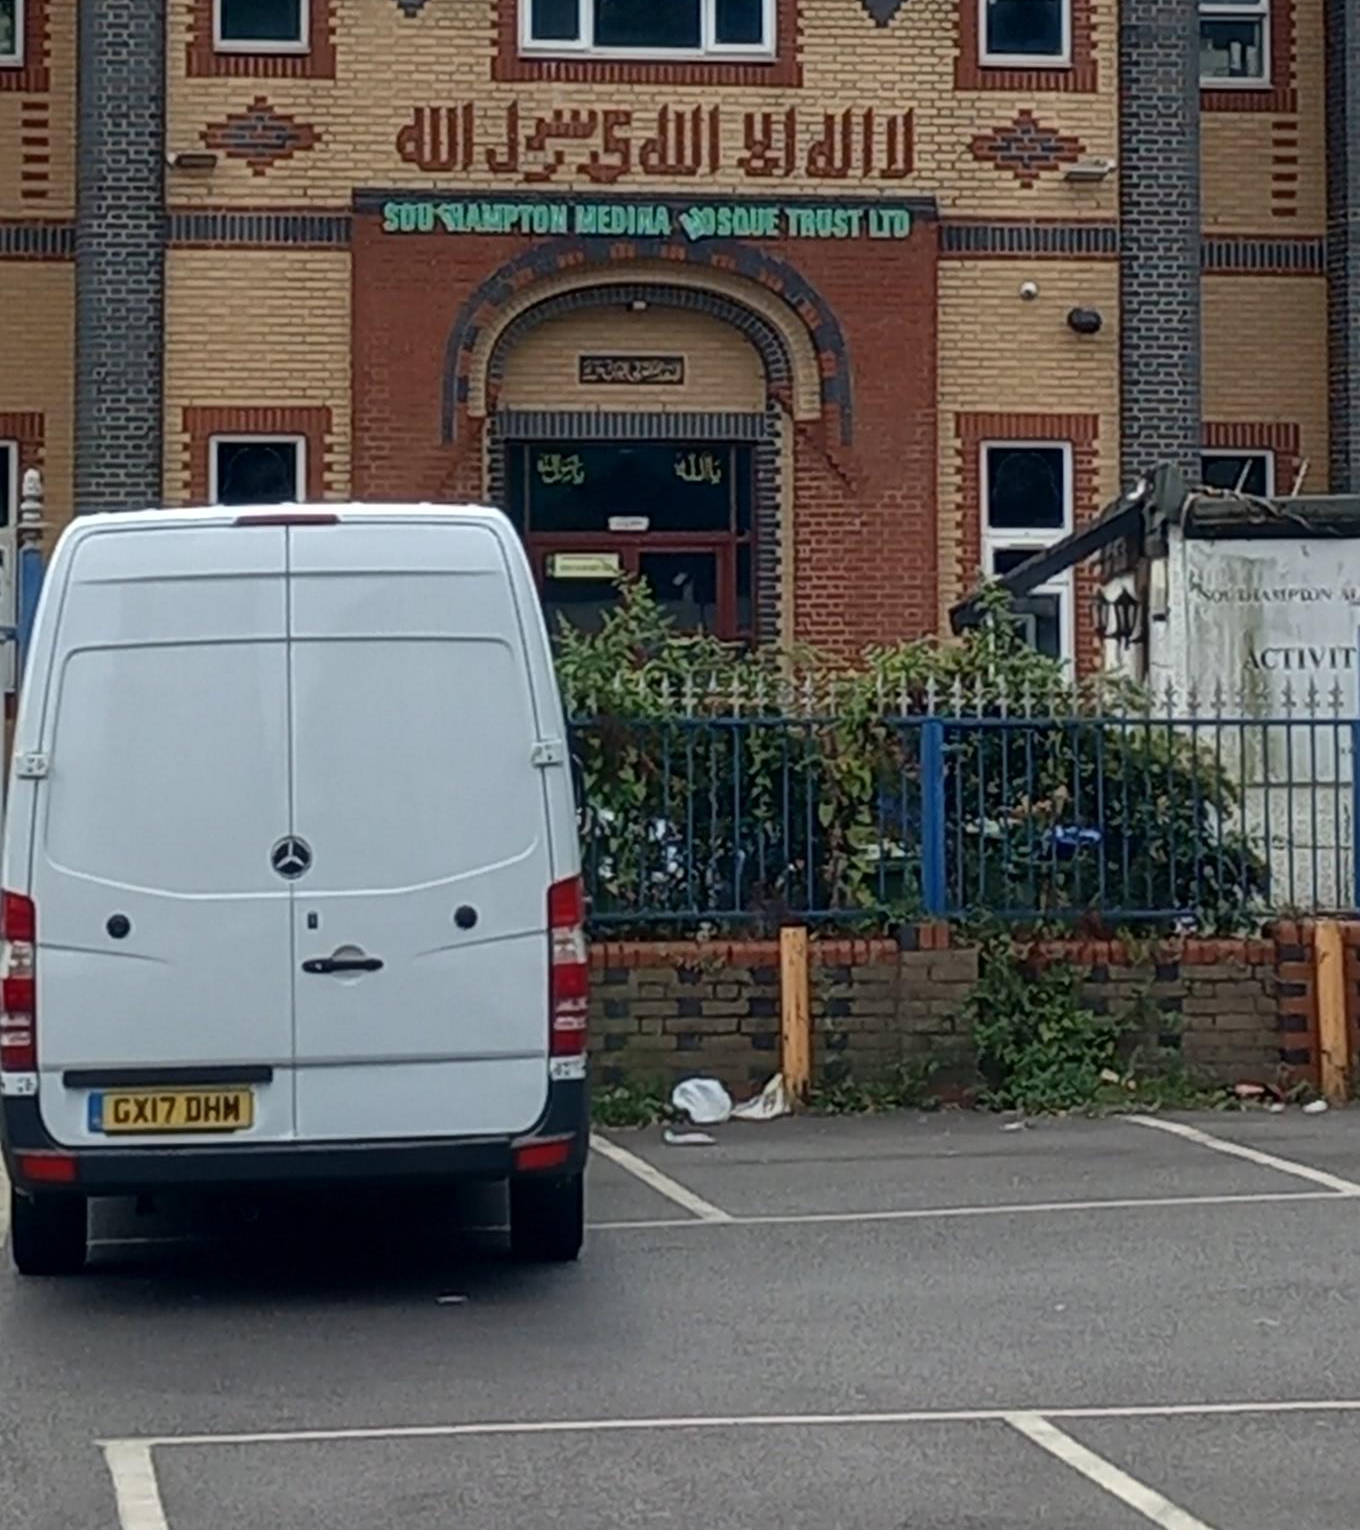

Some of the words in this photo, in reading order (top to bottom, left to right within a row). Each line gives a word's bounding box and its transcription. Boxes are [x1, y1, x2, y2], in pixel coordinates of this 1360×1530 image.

[574, 204, 671, 237] MEDINA
[679, 206, 780, 240] MOSQUE
[785, 207, 865, 238] TRUST
[868, 208, 911, 238] LTD
[1243, 646, 1358, 670] ACTIVIT
[113, 1095, 177, 1124] GX17
[184, 1094, 241, 1123] DHM
